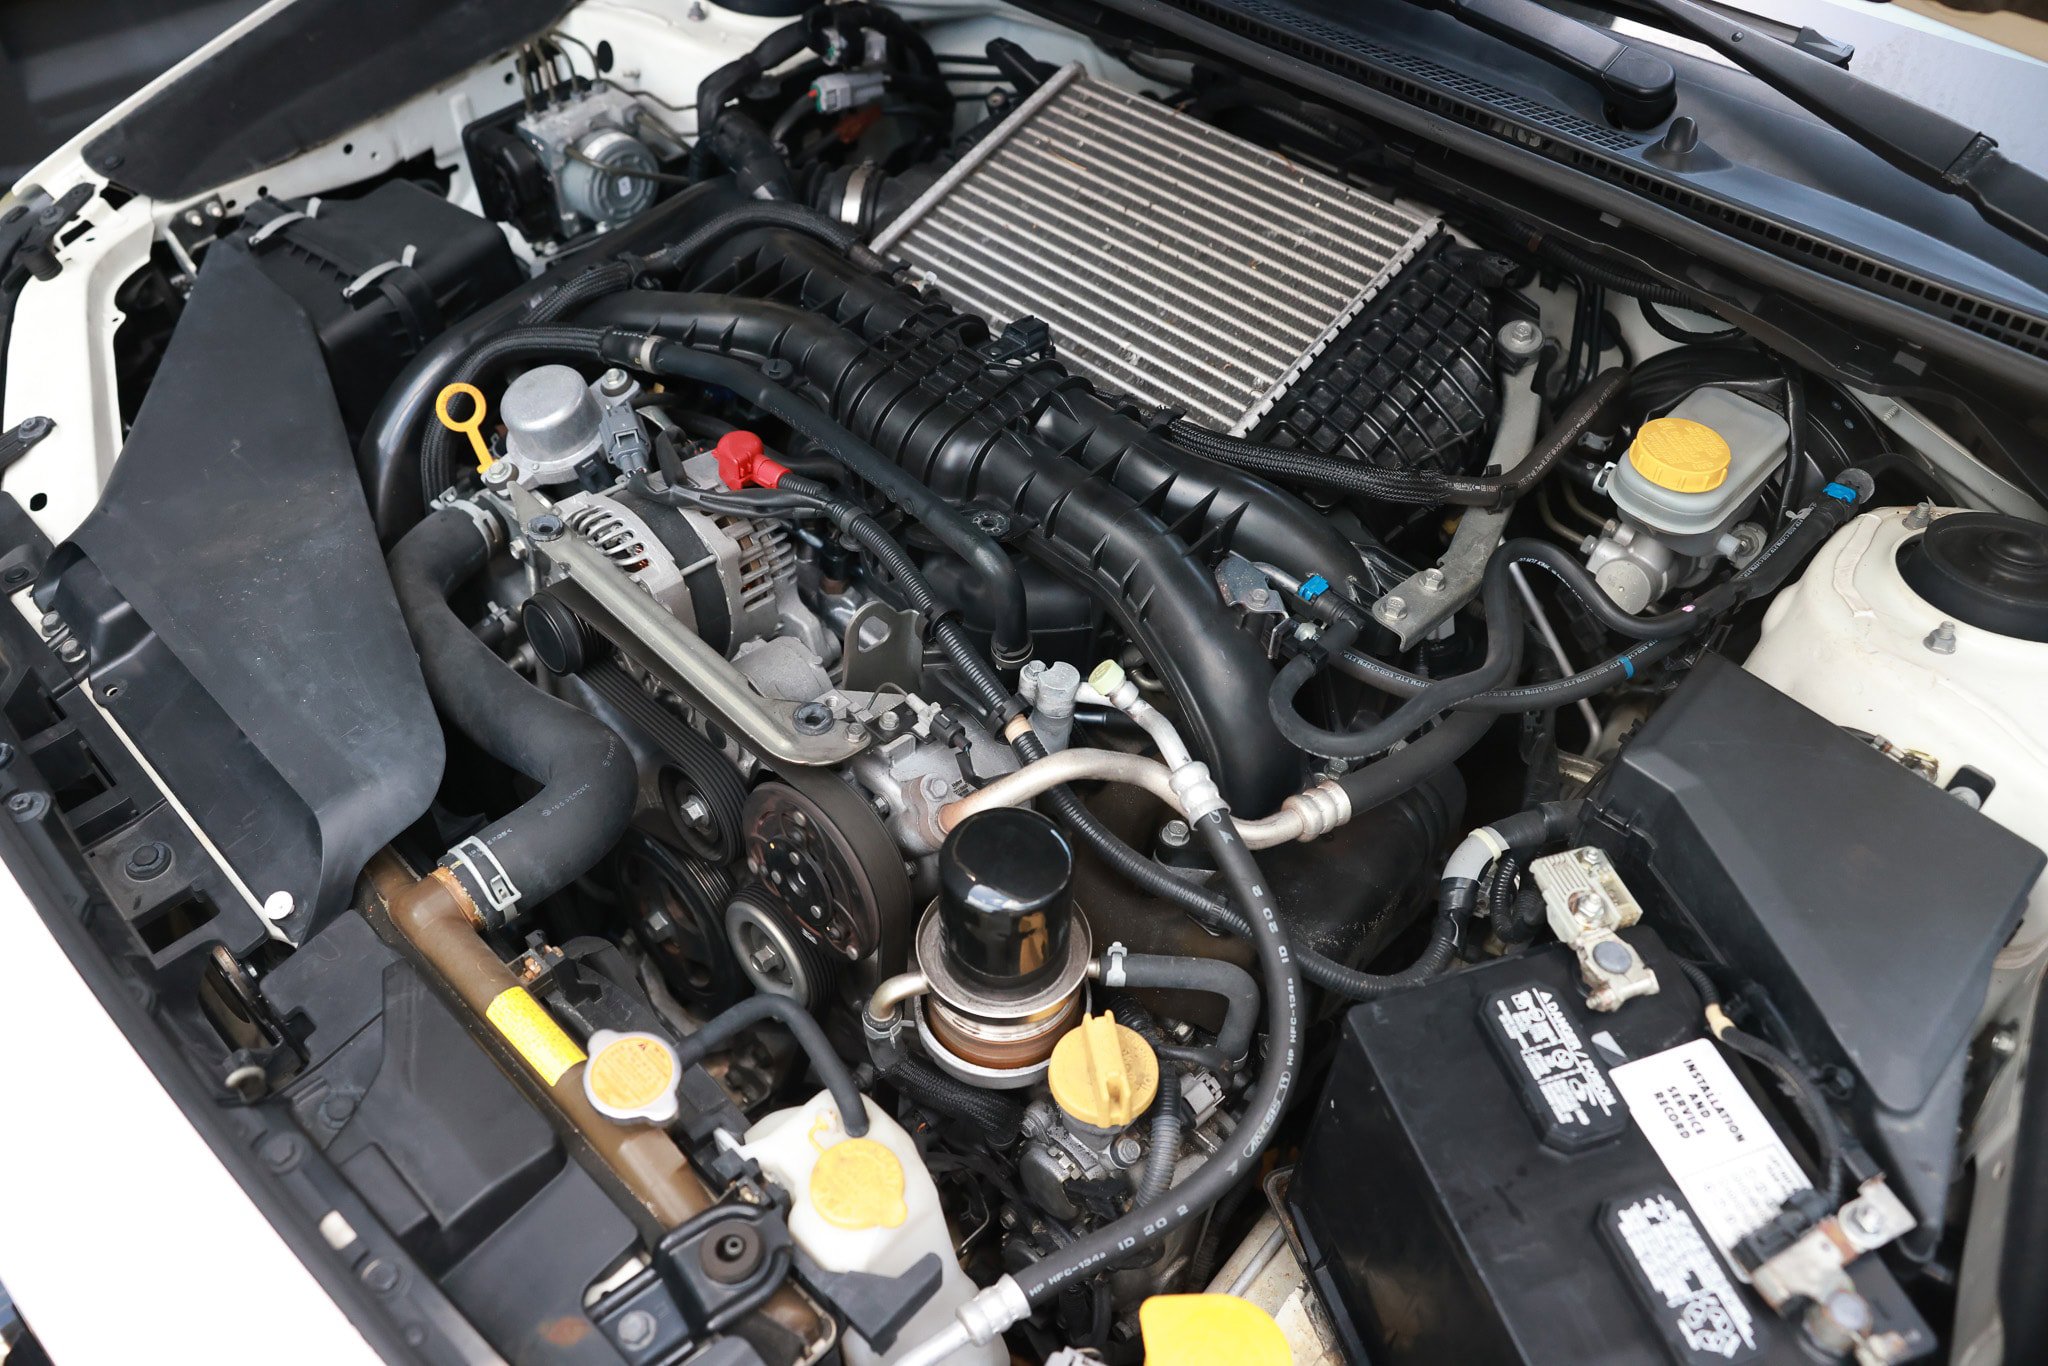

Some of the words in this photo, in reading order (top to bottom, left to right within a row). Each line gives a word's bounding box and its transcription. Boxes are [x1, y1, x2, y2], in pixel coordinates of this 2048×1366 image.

[1252, 885, 1264, 897] 2
[1263, 908, 1279, 933] 20
[1278, 946, 1289, 963] ID
[1287, 1049, 1294, 1066] HP
[1666, 1085, 1705, 1135] SERVICE
[1682, 1058, 1745, 1143] INSTALLATION
[1688, 1092, 1711, 1119] AND
[1653, 1091, 1691, 1140] RECORD
[1029, 1283, 1045, 1297] HP
[1118, 1236, 1136, 1251] ID
[1143, 1217, 1167, 1236] 20
[1176, 1204, 1189, 1217] 2
